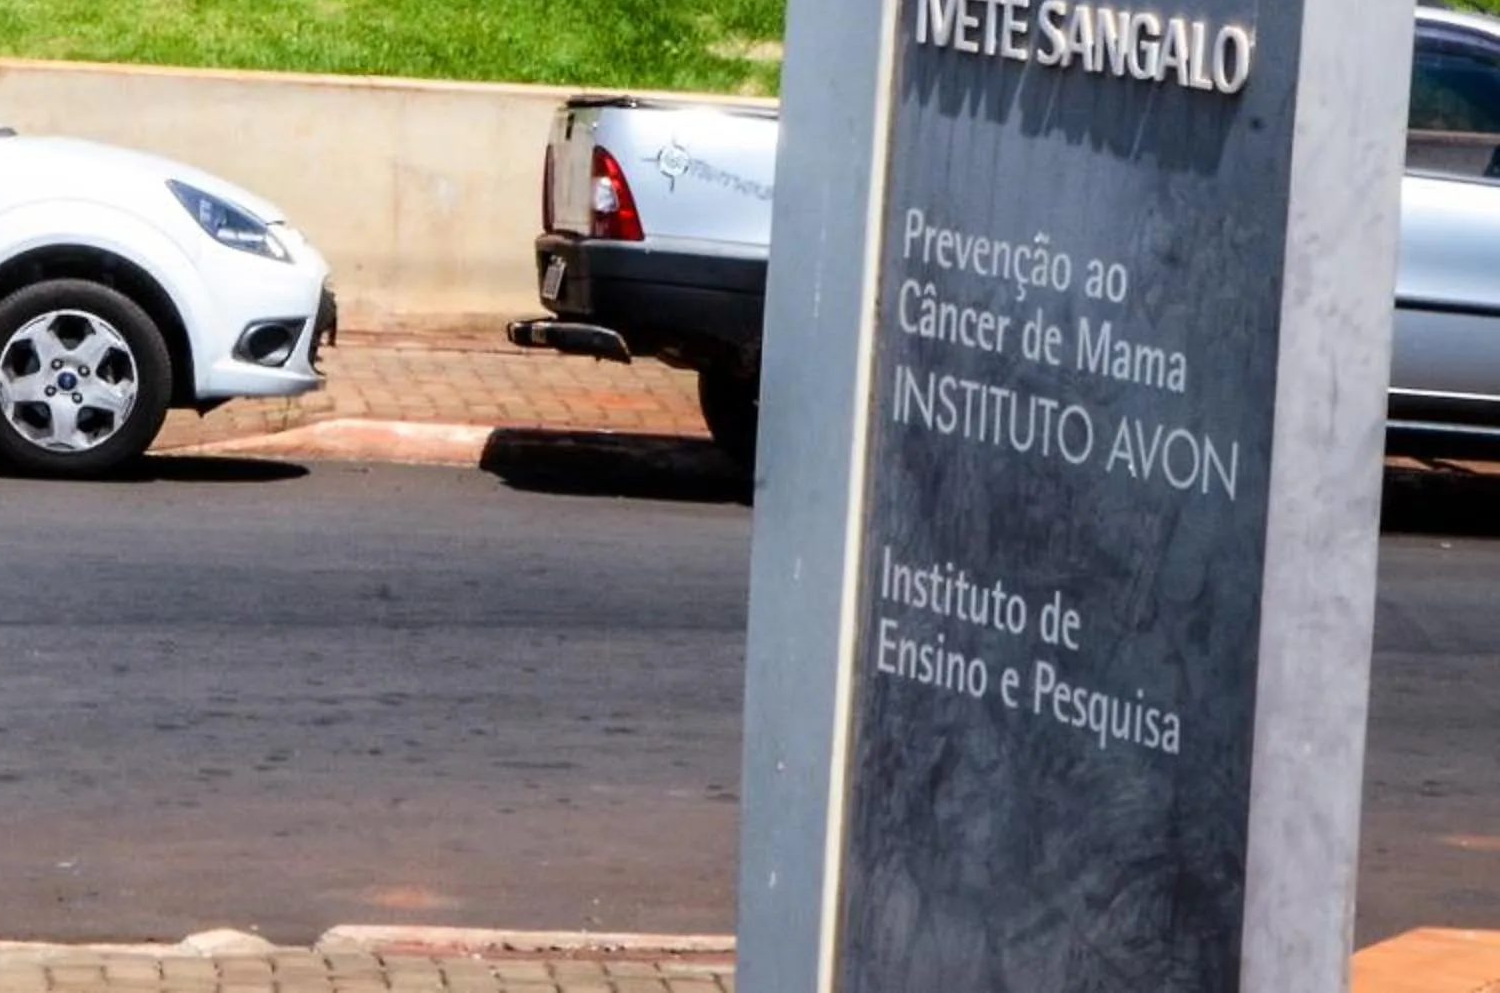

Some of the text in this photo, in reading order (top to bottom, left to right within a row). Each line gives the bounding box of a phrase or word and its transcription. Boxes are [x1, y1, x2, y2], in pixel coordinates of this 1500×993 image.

[903, 207, 1129, 303] Prevenção ao
[899, 279, 1189, 393] Câncer de Mama
[893, 365, 1240, 502] INSTITUTO AVON
[881, 546, 1082, 650] Instituto de
[876, 619, 1182, 755] Ensino e Pesquisa
